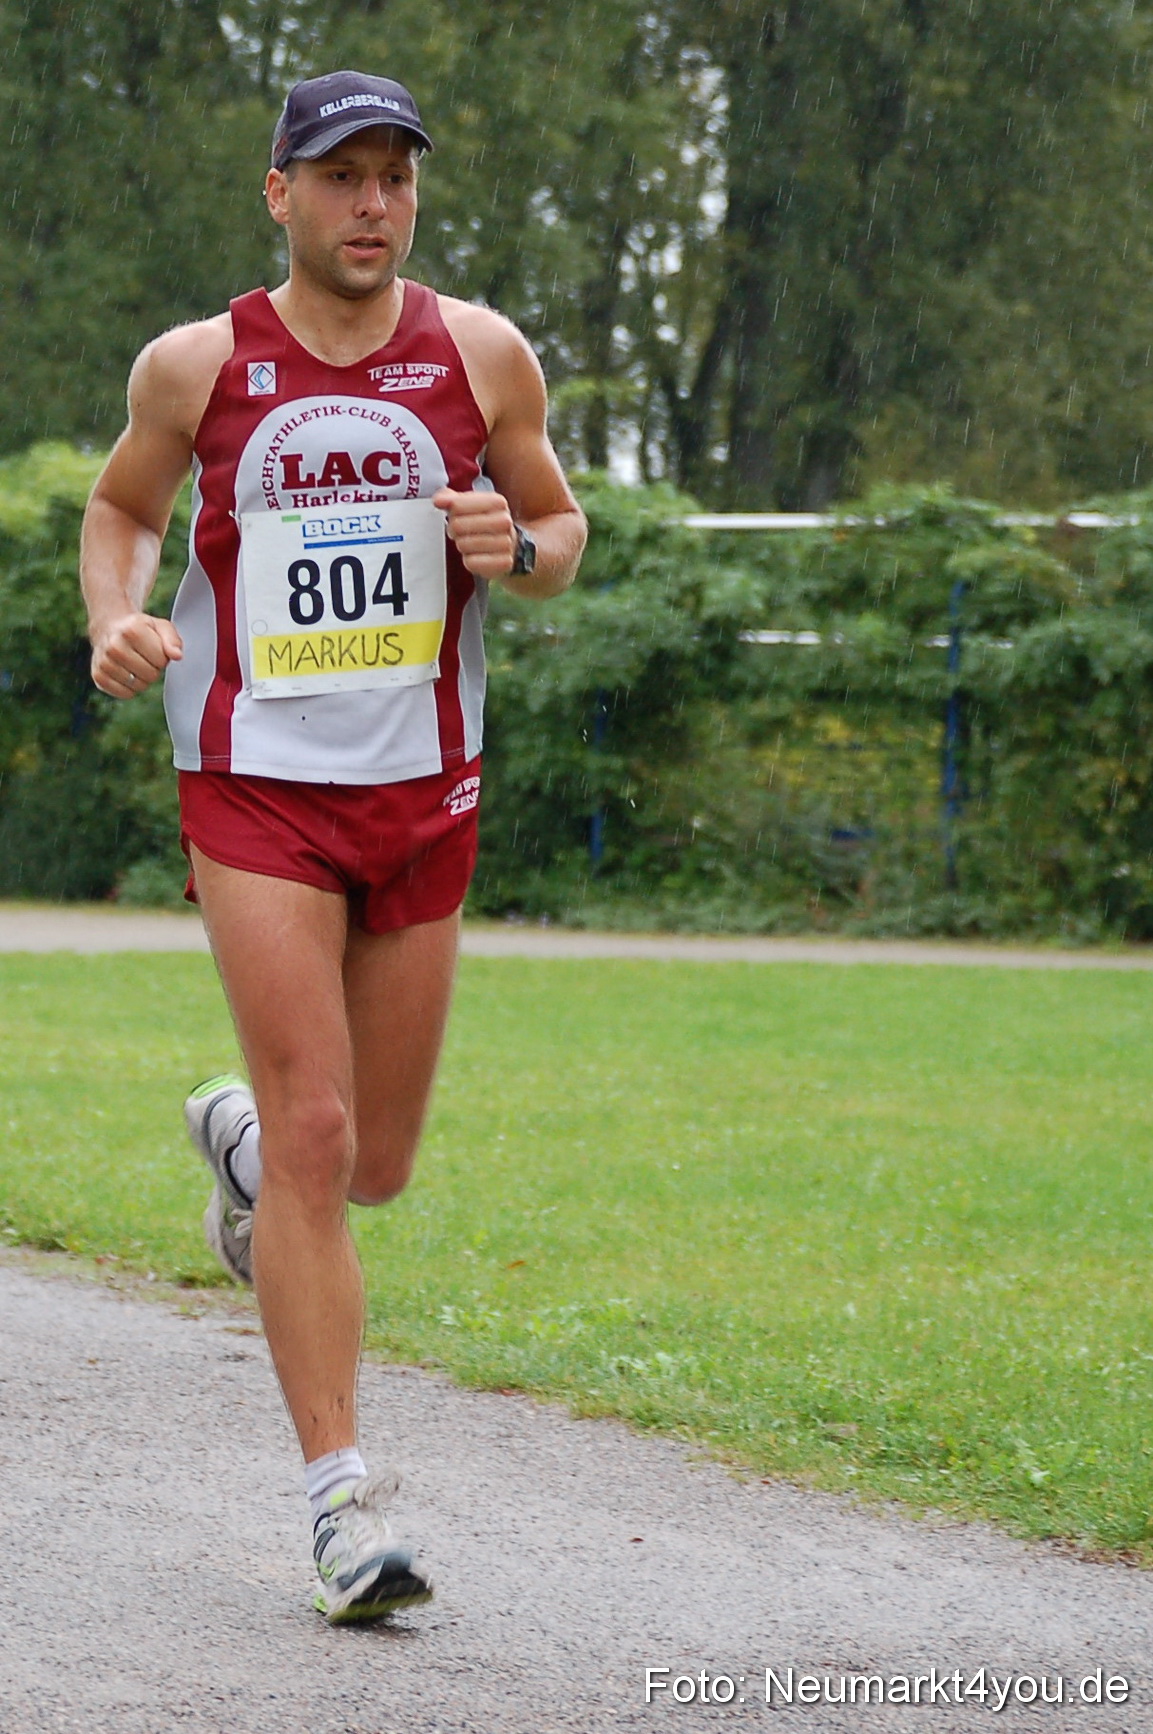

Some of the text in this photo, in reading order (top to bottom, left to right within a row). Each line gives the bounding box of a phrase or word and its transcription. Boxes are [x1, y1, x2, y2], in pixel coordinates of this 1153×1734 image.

[367, 362, 449, 381] TEAM SPORT
[379, 375, 435, 393] ZENS
[262, 405, 420, 510] EICHTATHLETIK-CLUB HARLEK
[279, 450, 402, 491] LAC
[291, 490, 389, 509] Harlekin
[302, 514, 382, 538] BOCK
[287, 551, 410, 626] 804
[268, 632, 405, 676] MARKUS
